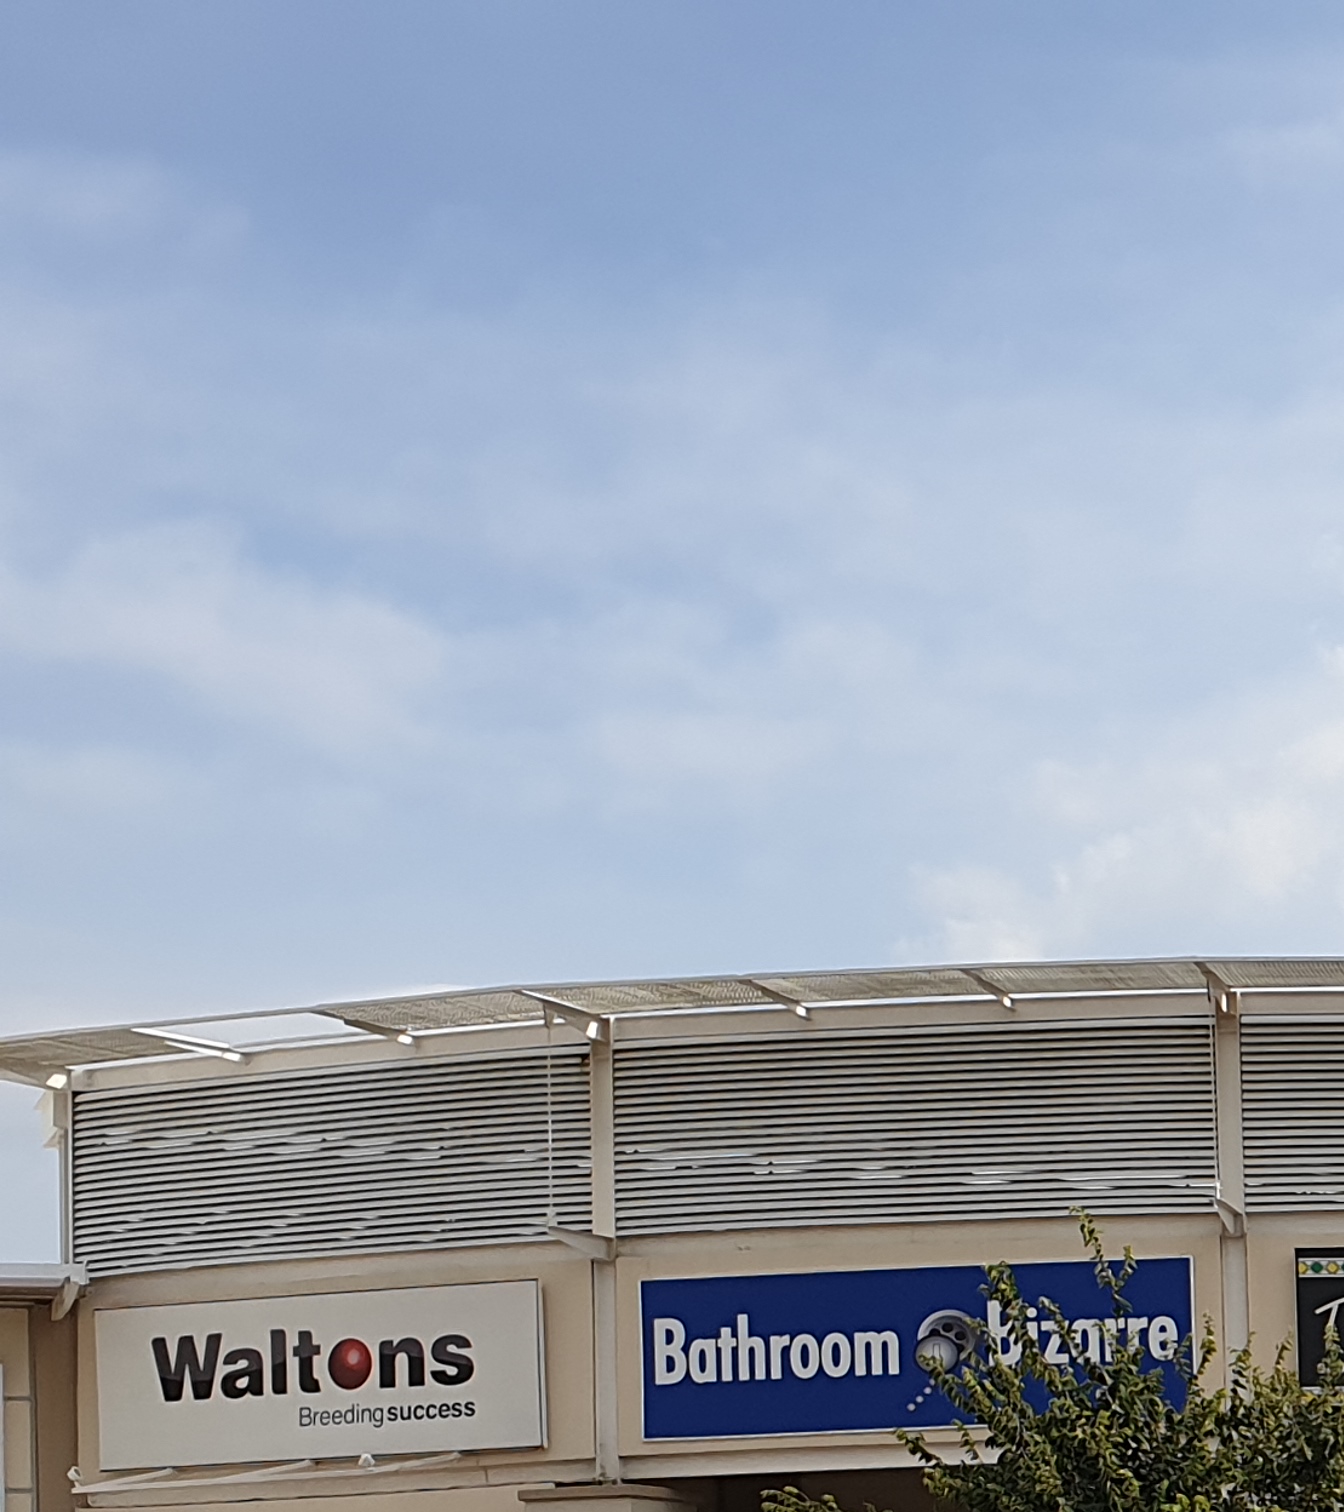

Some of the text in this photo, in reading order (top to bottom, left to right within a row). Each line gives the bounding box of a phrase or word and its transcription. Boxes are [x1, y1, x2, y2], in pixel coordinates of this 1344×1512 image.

[151, 1328, 474, 1402] Waltons
[653, 1313, 899, 1387] Bathroom
[387, 1400, 475, 1422] success
